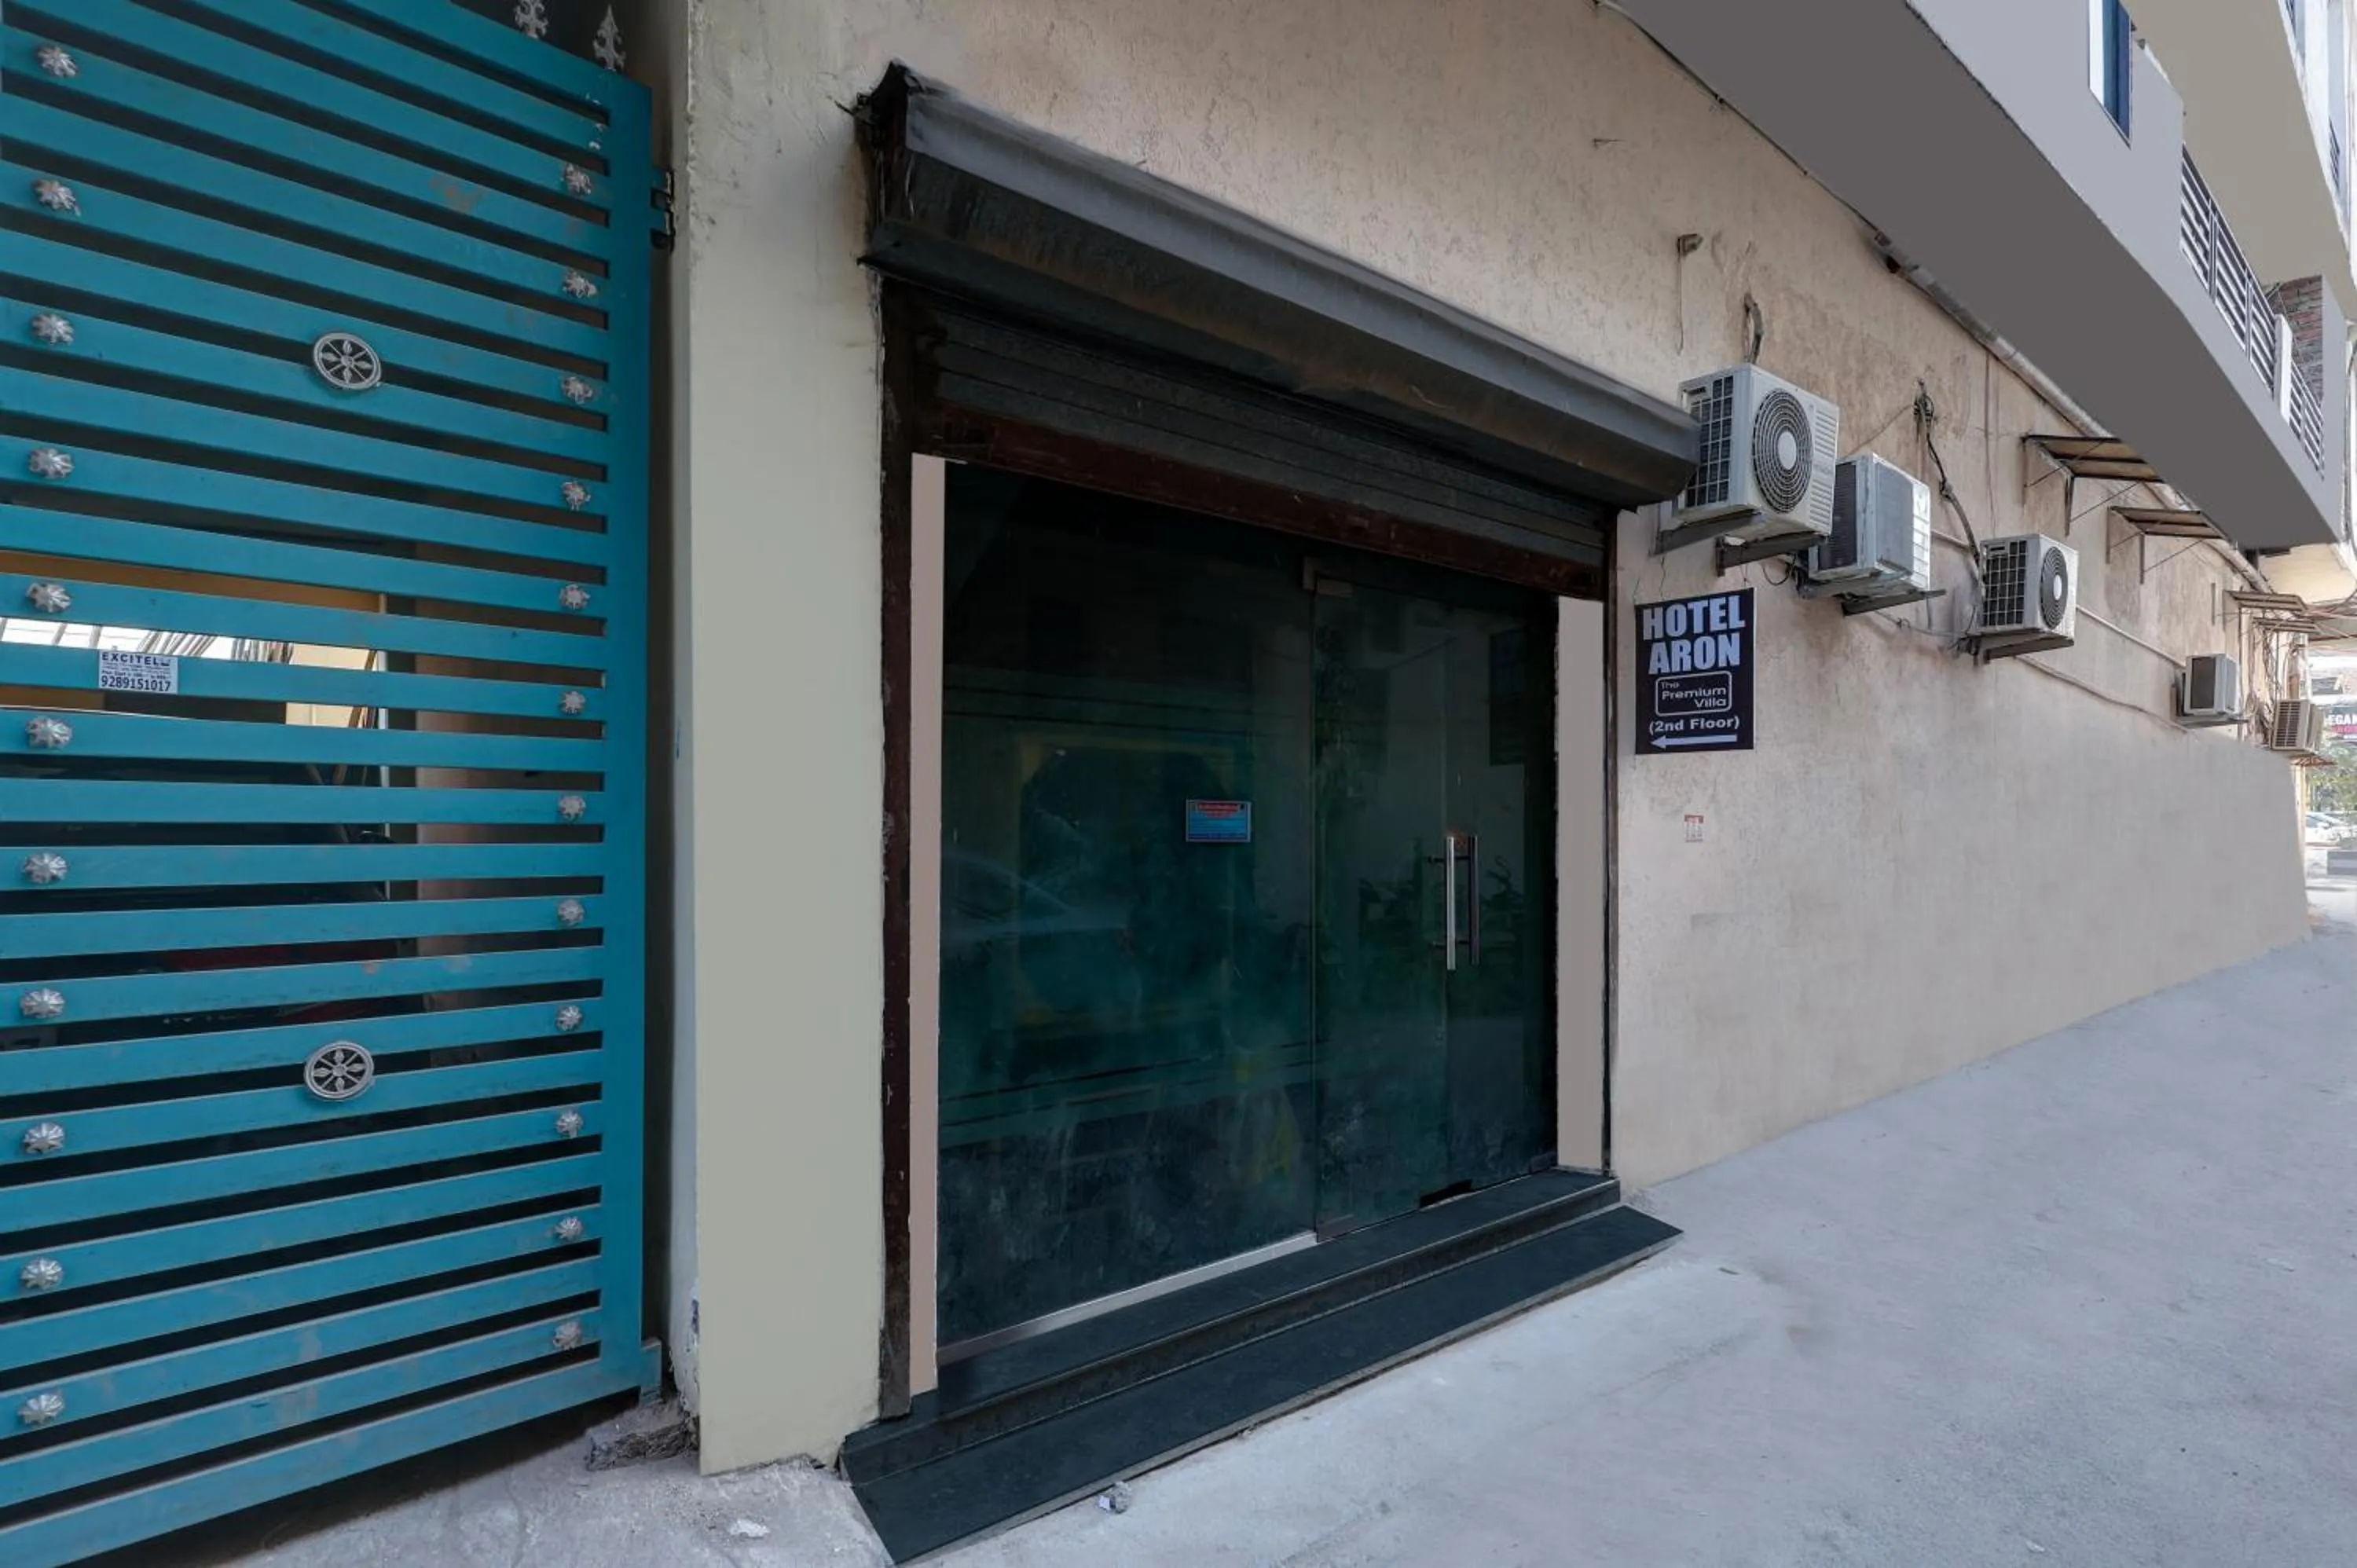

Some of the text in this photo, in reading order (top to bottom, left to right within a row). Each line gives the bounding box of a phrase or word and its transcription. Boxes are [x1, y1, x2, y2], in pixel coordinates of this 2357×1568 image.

[1643, 595, 1746, 640] HOTEL
[102, 652, 159, 665] EXCITEL
[1648, 633, 1740, 675] ARON
[101, 676, 171, 691] 9289151017
[1661, 681, 1680, 690] The
[1662, 687, 1727, 701] Premium
[1694, 696, 1727, 709] Villa
[1648, 716, 1740, 735] (2nd Floor)
